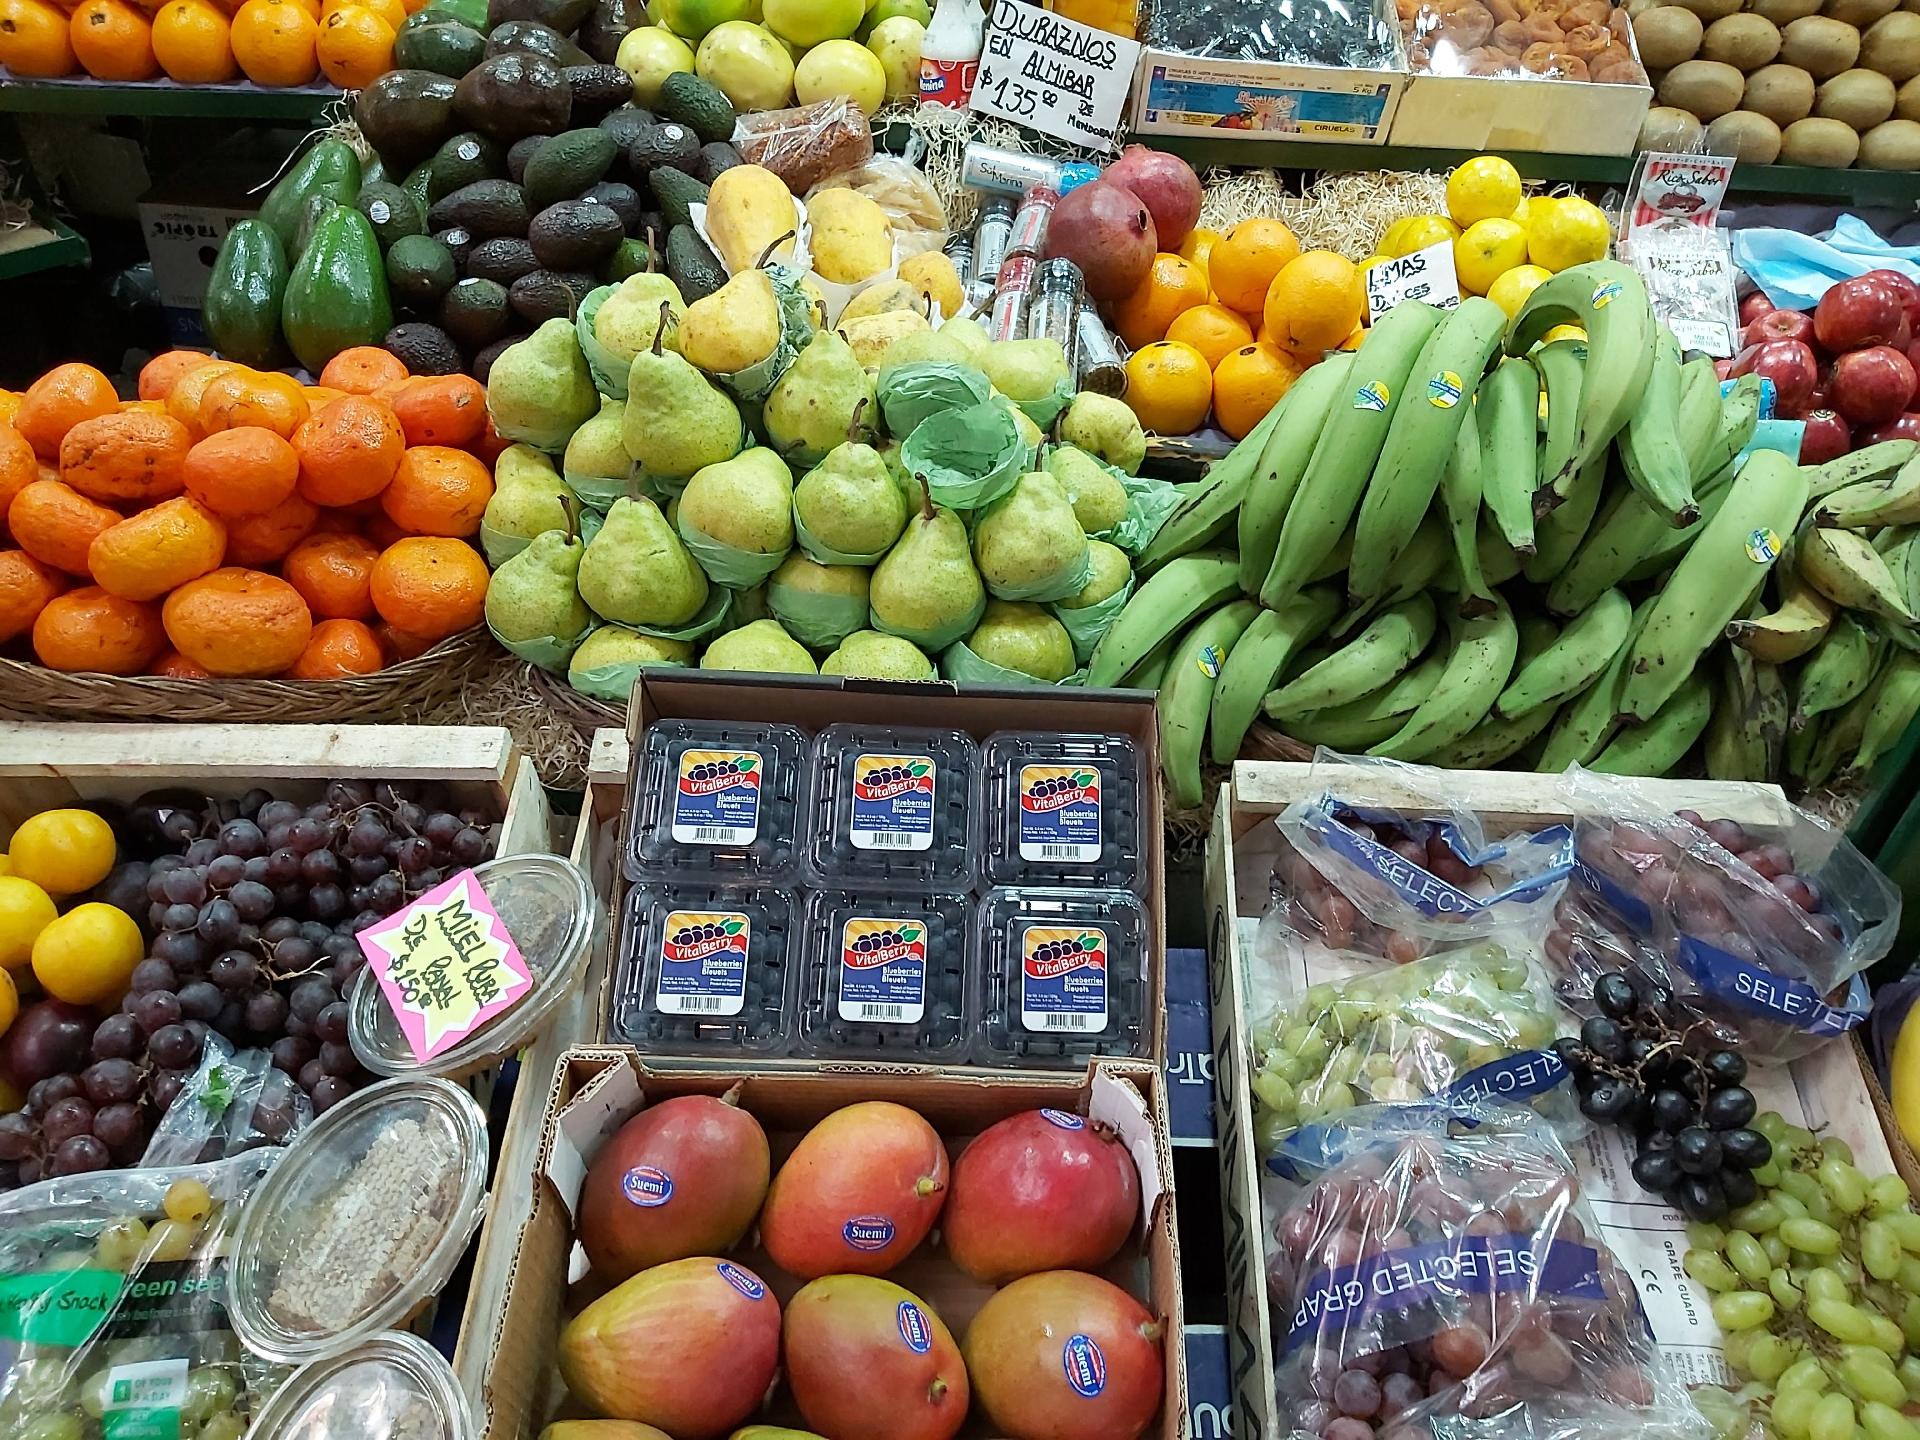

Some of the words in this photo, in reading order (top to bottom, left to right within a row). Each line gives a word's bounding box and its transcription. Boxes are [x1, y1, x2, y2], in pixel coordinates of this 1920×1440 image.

[991, 2, 1117, 66] DURAZNOS
[989, 35, 1014, 57] EN
[1078, 100, 1094, 116] DE
[1314, 124, 1356, 133] CIRUELAS
[690, 774, 747, 793] VitalBerry
[866, 779, 921, 798] VitalBerry
[1032, 790, 1086, 810] VitalBerry
[675, 938, 733, 959] VitalBerry
[855, 945, 911, 966] VitalBerry
[1036, 953, 1091, 975] VitalBerry
[630, 1176, 664, 1194] Suemi
[851, 1226, 886, 1239] Suemi
[725, 1267, 758, 1292] Suemi
[1372, 1248, 1538, 1296] SELECTED
[1664, 1240, 1683, 1281] GRAPE
[1677, 1282, 1698, 1327] GUARD
[57, 1290, 110, 1312] Snack
[905, 1309, 925, 1343] Suemi
[1073, 1344, 1096, 1387] Suemi
